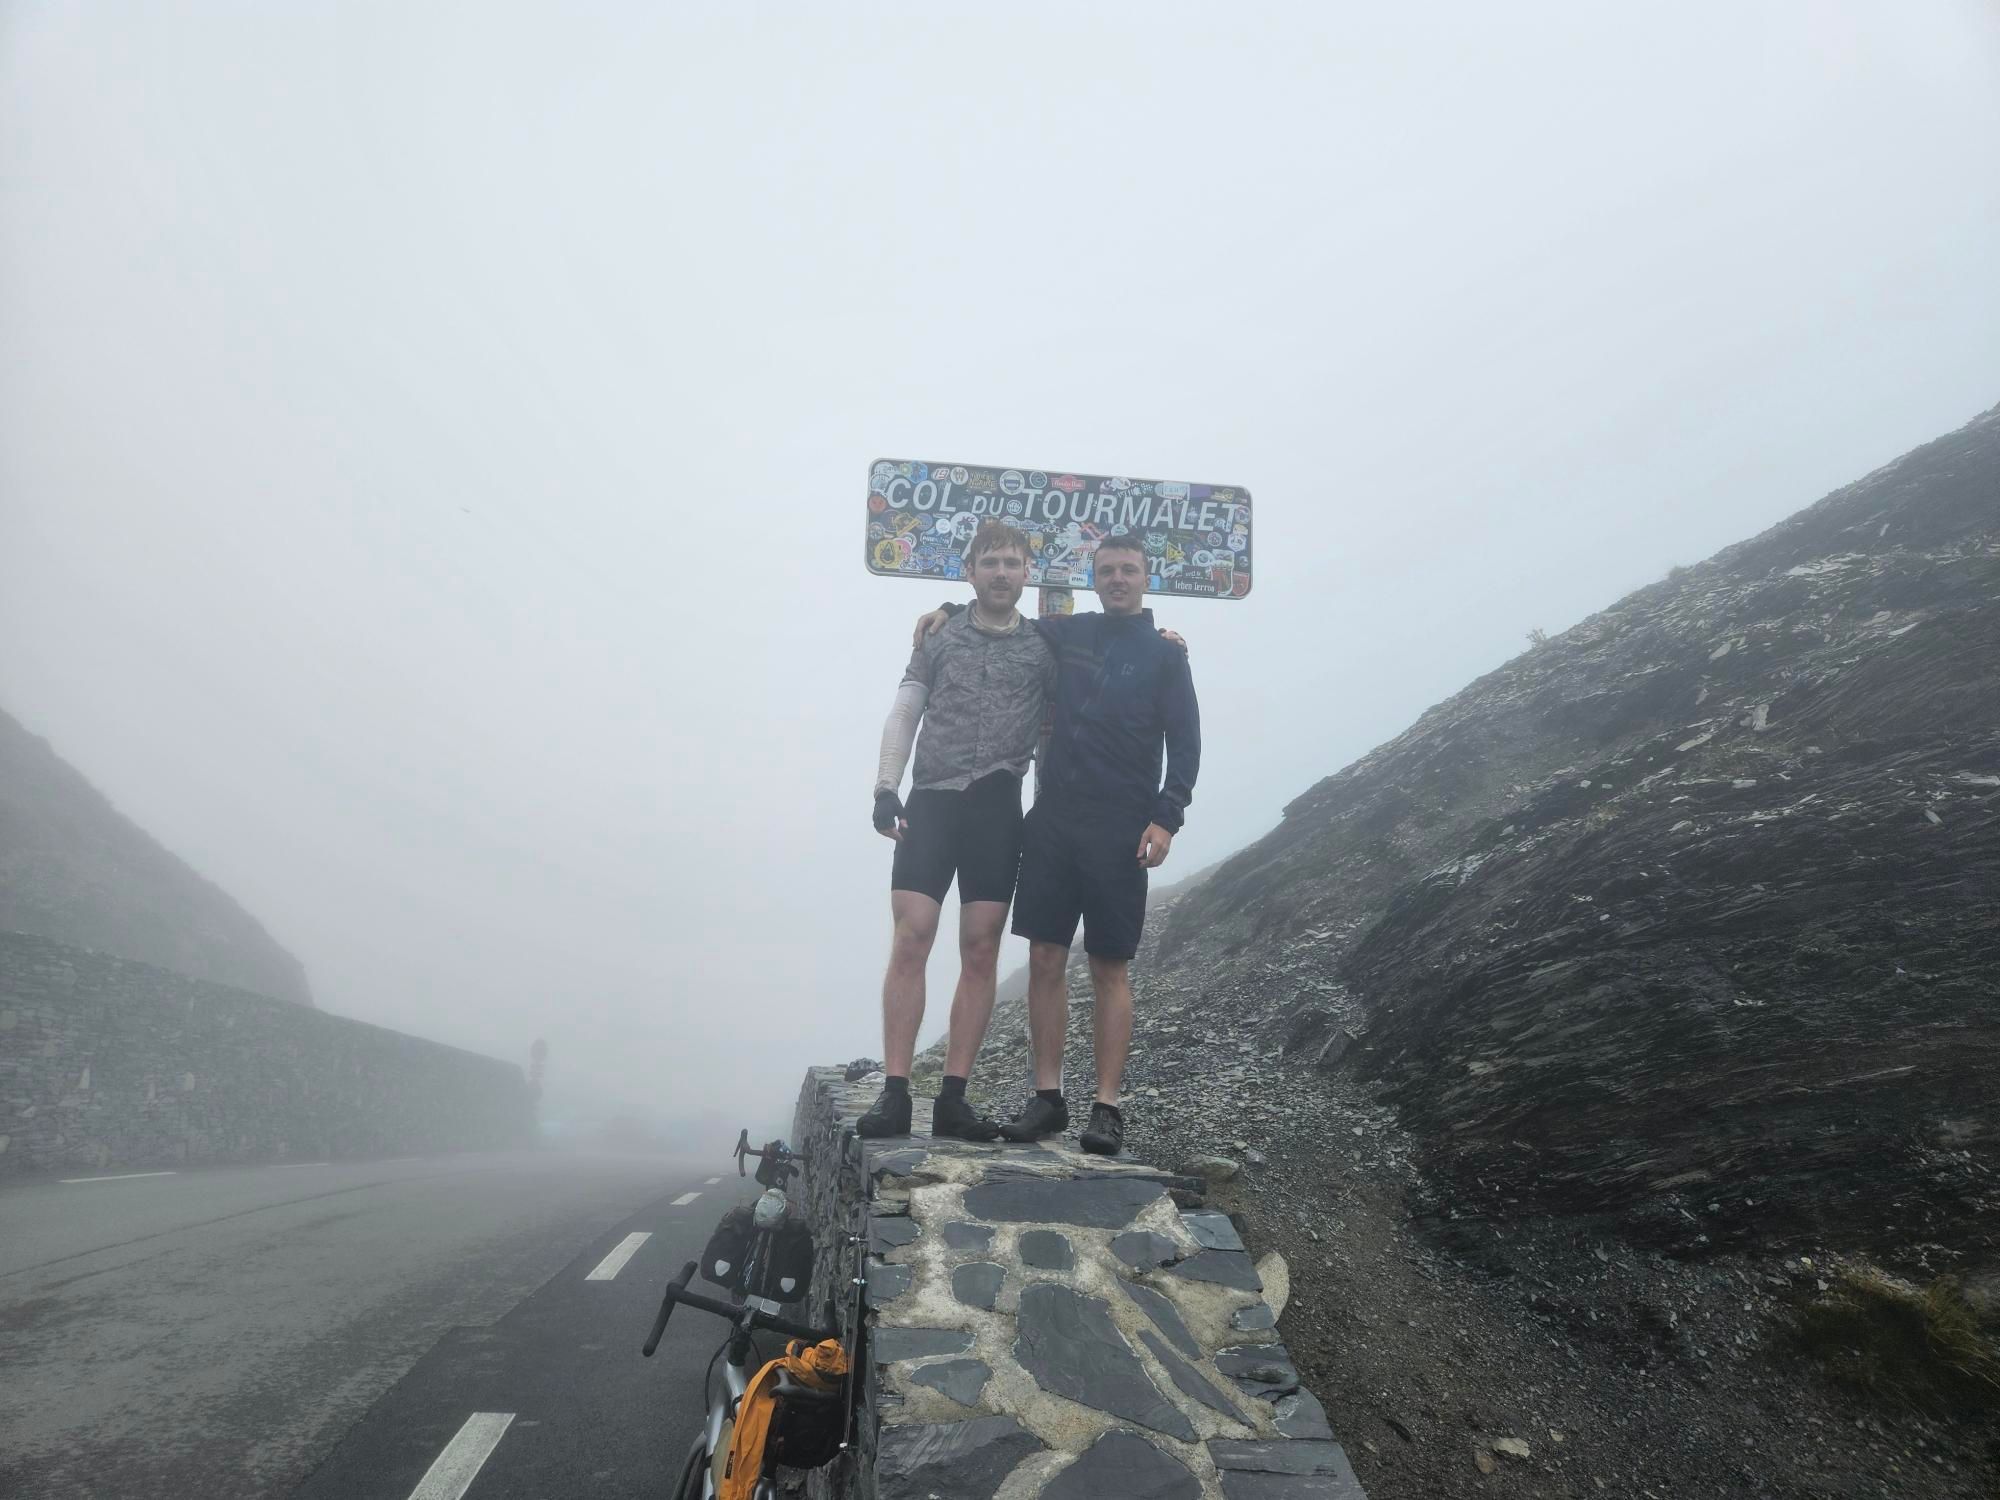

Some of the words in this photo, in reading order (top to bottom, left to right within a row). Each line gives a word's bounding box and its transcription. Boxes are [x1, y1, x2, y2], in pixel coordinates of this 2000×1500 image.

[886, 478, 956, 513] COL
[971, 495, 1004, 515] DU
[1021, 488, 1239, 533] TOURMALET
